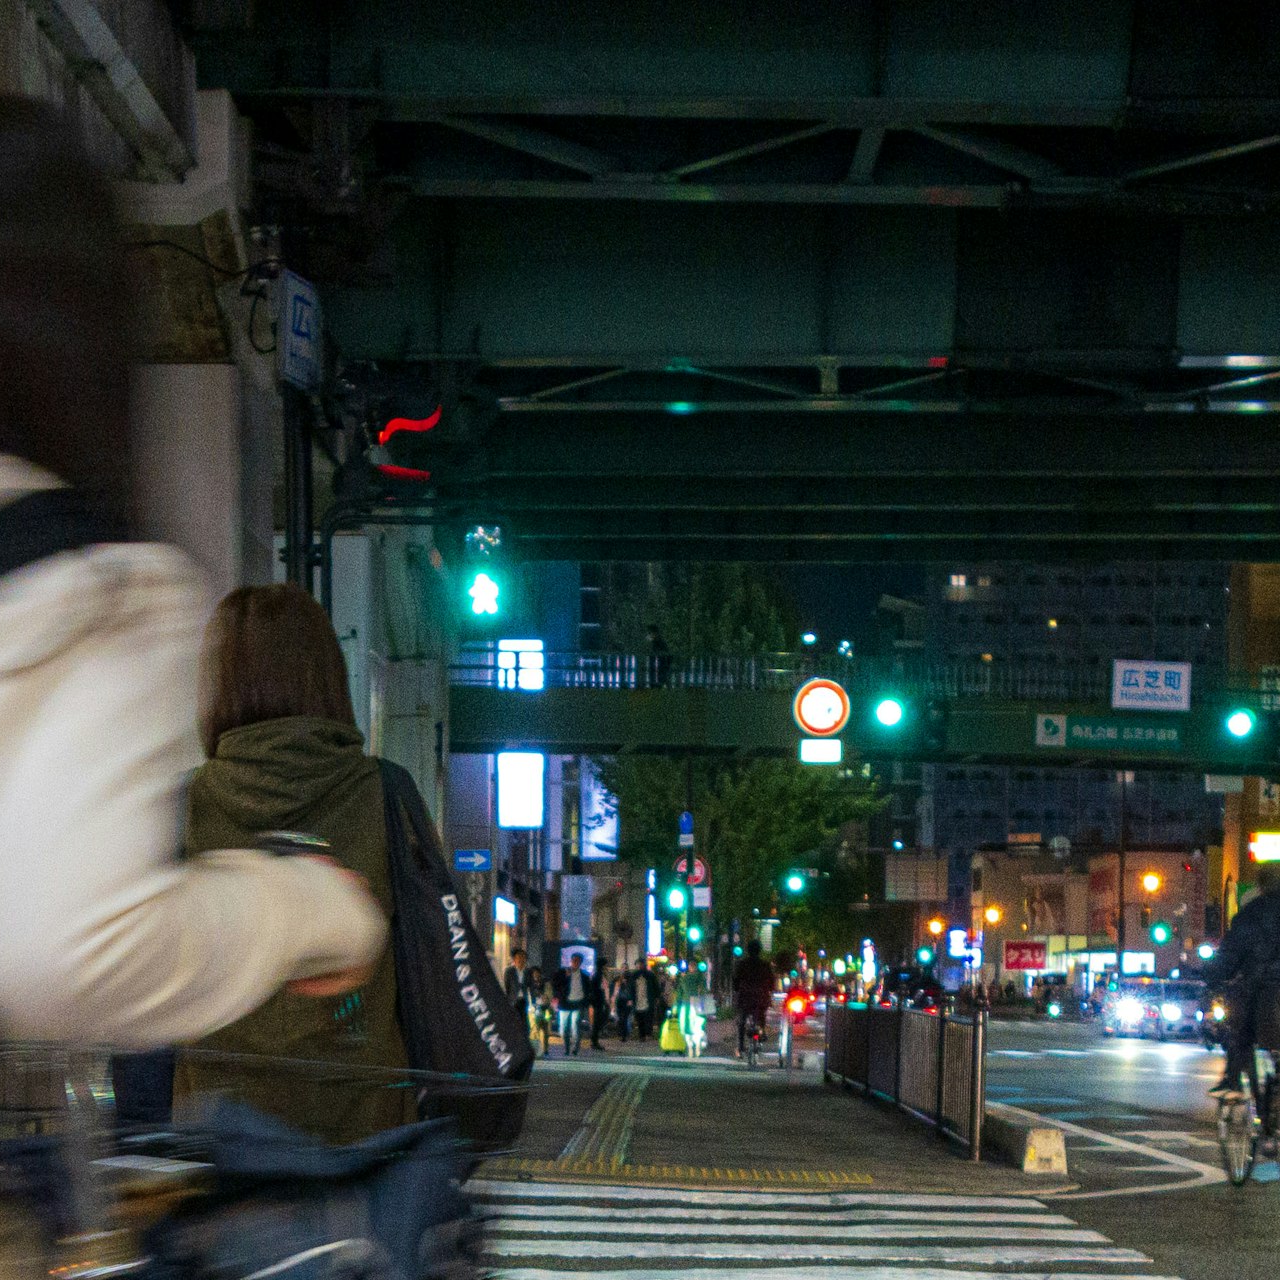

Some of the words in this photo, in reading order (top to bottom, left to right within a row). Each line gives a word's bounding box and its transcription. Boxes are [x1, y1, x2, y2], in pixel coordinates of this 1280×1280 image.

[1122, 669, 1182, 690] 広芝町
[441, 894, 471, 961] DEAN
